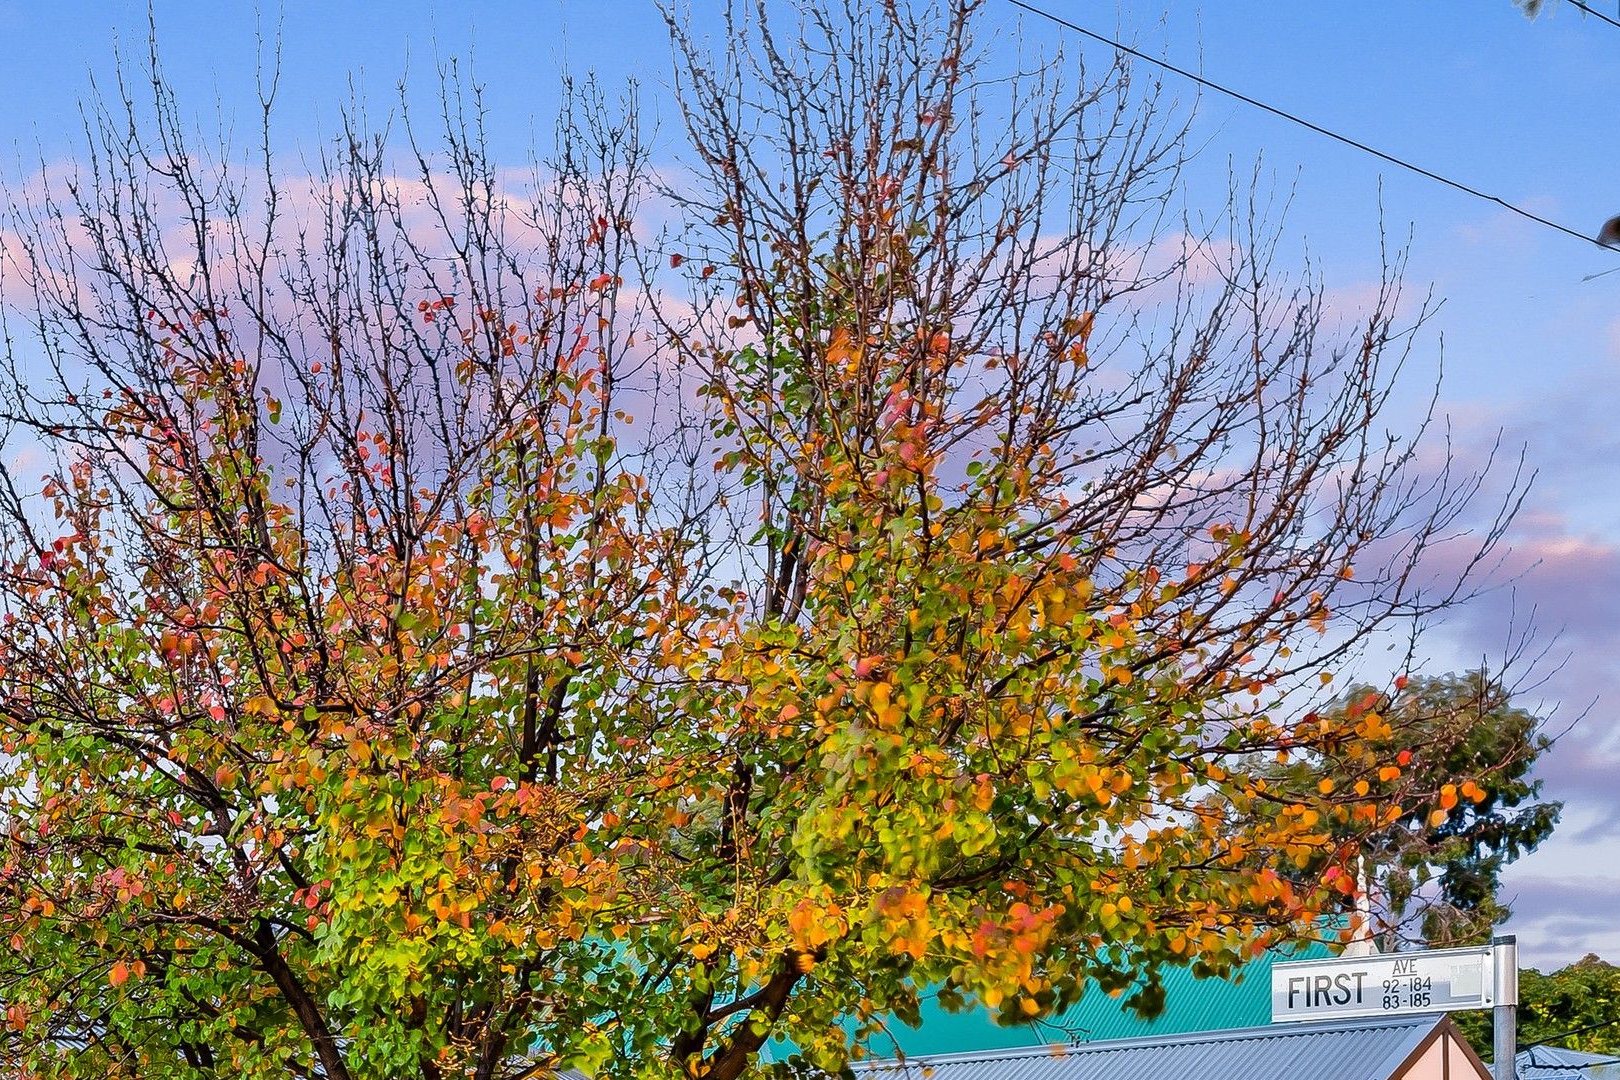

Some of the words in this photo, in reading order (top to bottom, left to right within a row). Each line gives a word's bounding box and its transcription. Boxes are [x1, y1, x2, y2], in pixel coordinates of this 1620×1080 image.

[1392, 958, 1418, 974] AVE
[1288, 972, 1368, 1009] FIRST
[1382, 977, 1432, 994] 92-184
[1382, 992, 1431, 1010] 83-185
